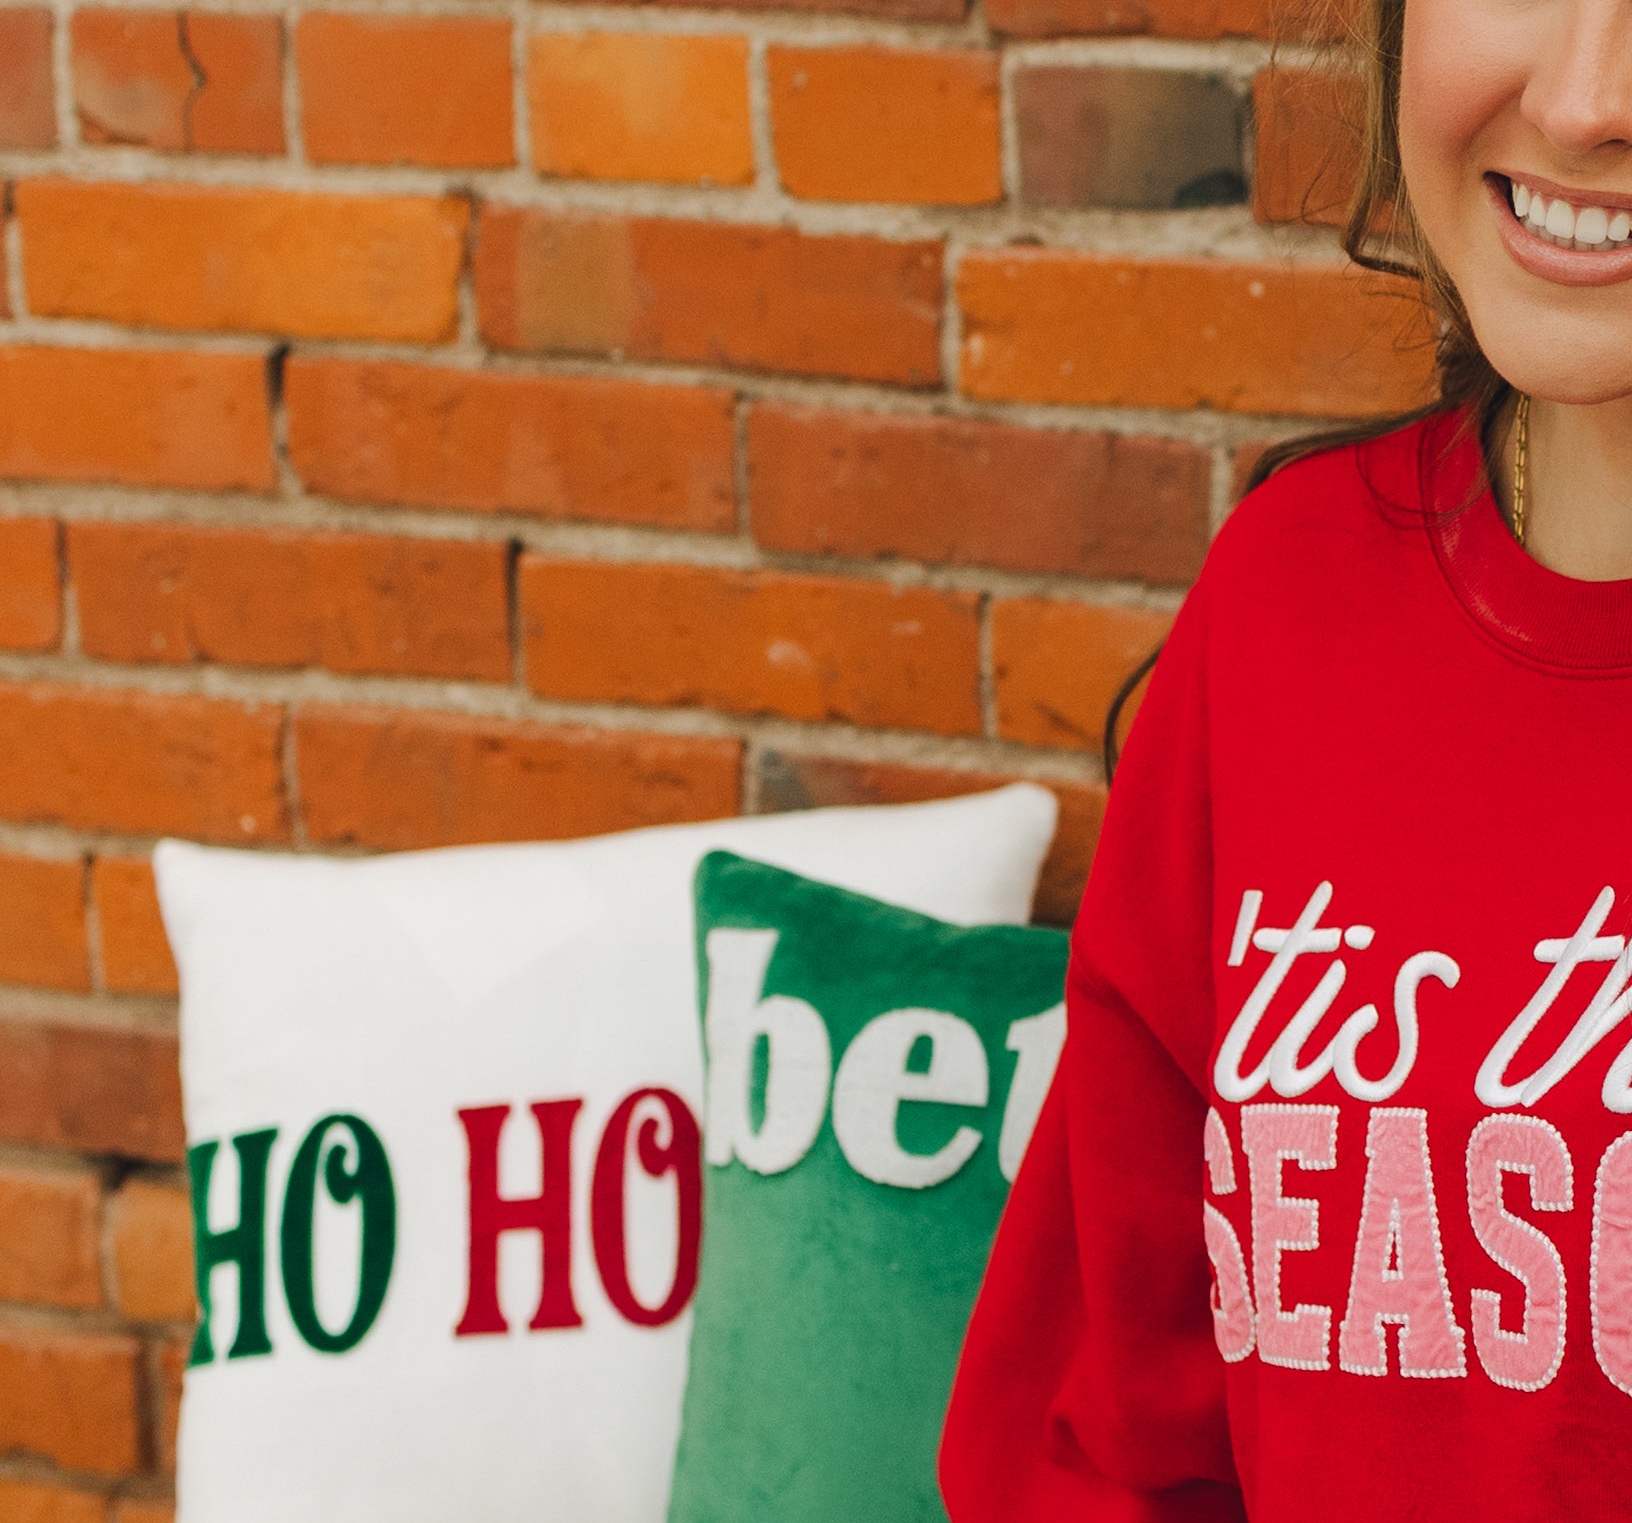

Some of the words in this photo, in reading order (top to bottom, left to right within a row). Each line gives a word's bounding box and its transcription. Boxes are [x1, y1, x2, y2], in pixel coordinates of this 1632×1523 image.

[1213, 880, 1461, 1103] 'tis
[187, 1113, 396, 1366] HO
[453, 1086, 704, 1338] HO
